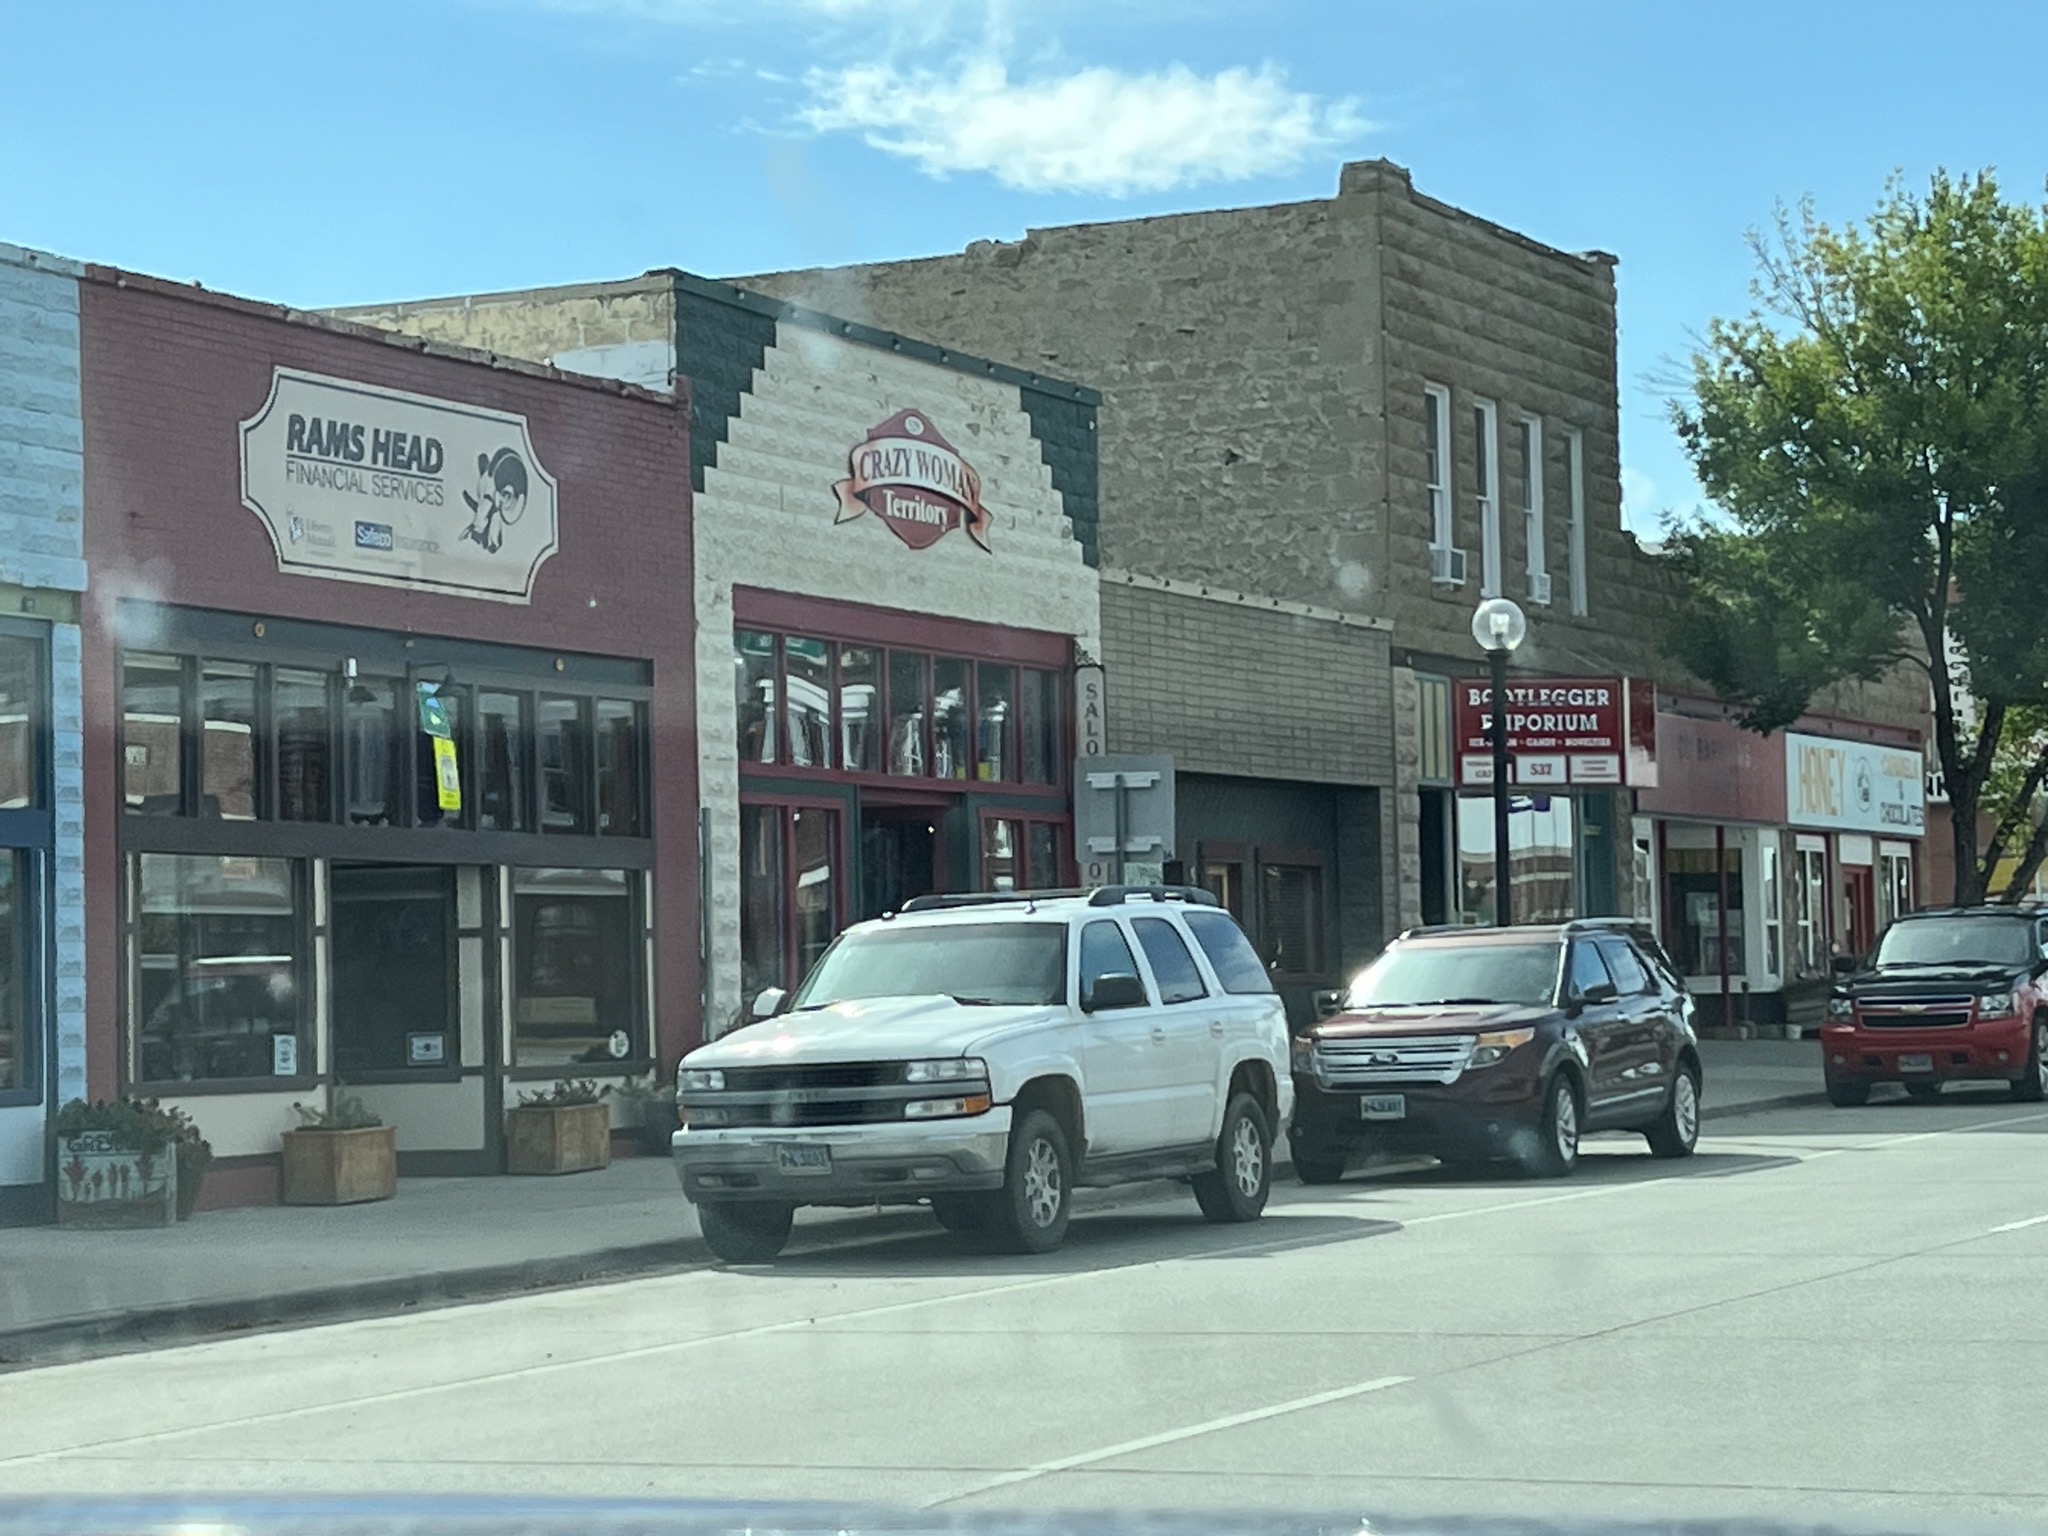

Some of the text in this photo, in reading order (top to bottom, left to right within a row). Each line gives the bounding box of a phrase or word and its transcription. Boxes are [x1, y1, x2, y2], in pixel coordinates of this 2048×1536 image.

[286, 413, 443, 474] RAMS HEAD
[860, 448, 913, 481] CRAZY
[286, 460, 444, 506] FINANCIAL SERVICES
[883, 489, 948, 532] Territory
[1085, 683, 1098, 756] SALO
[1481, 714, 1598, 732] EPORIUM
